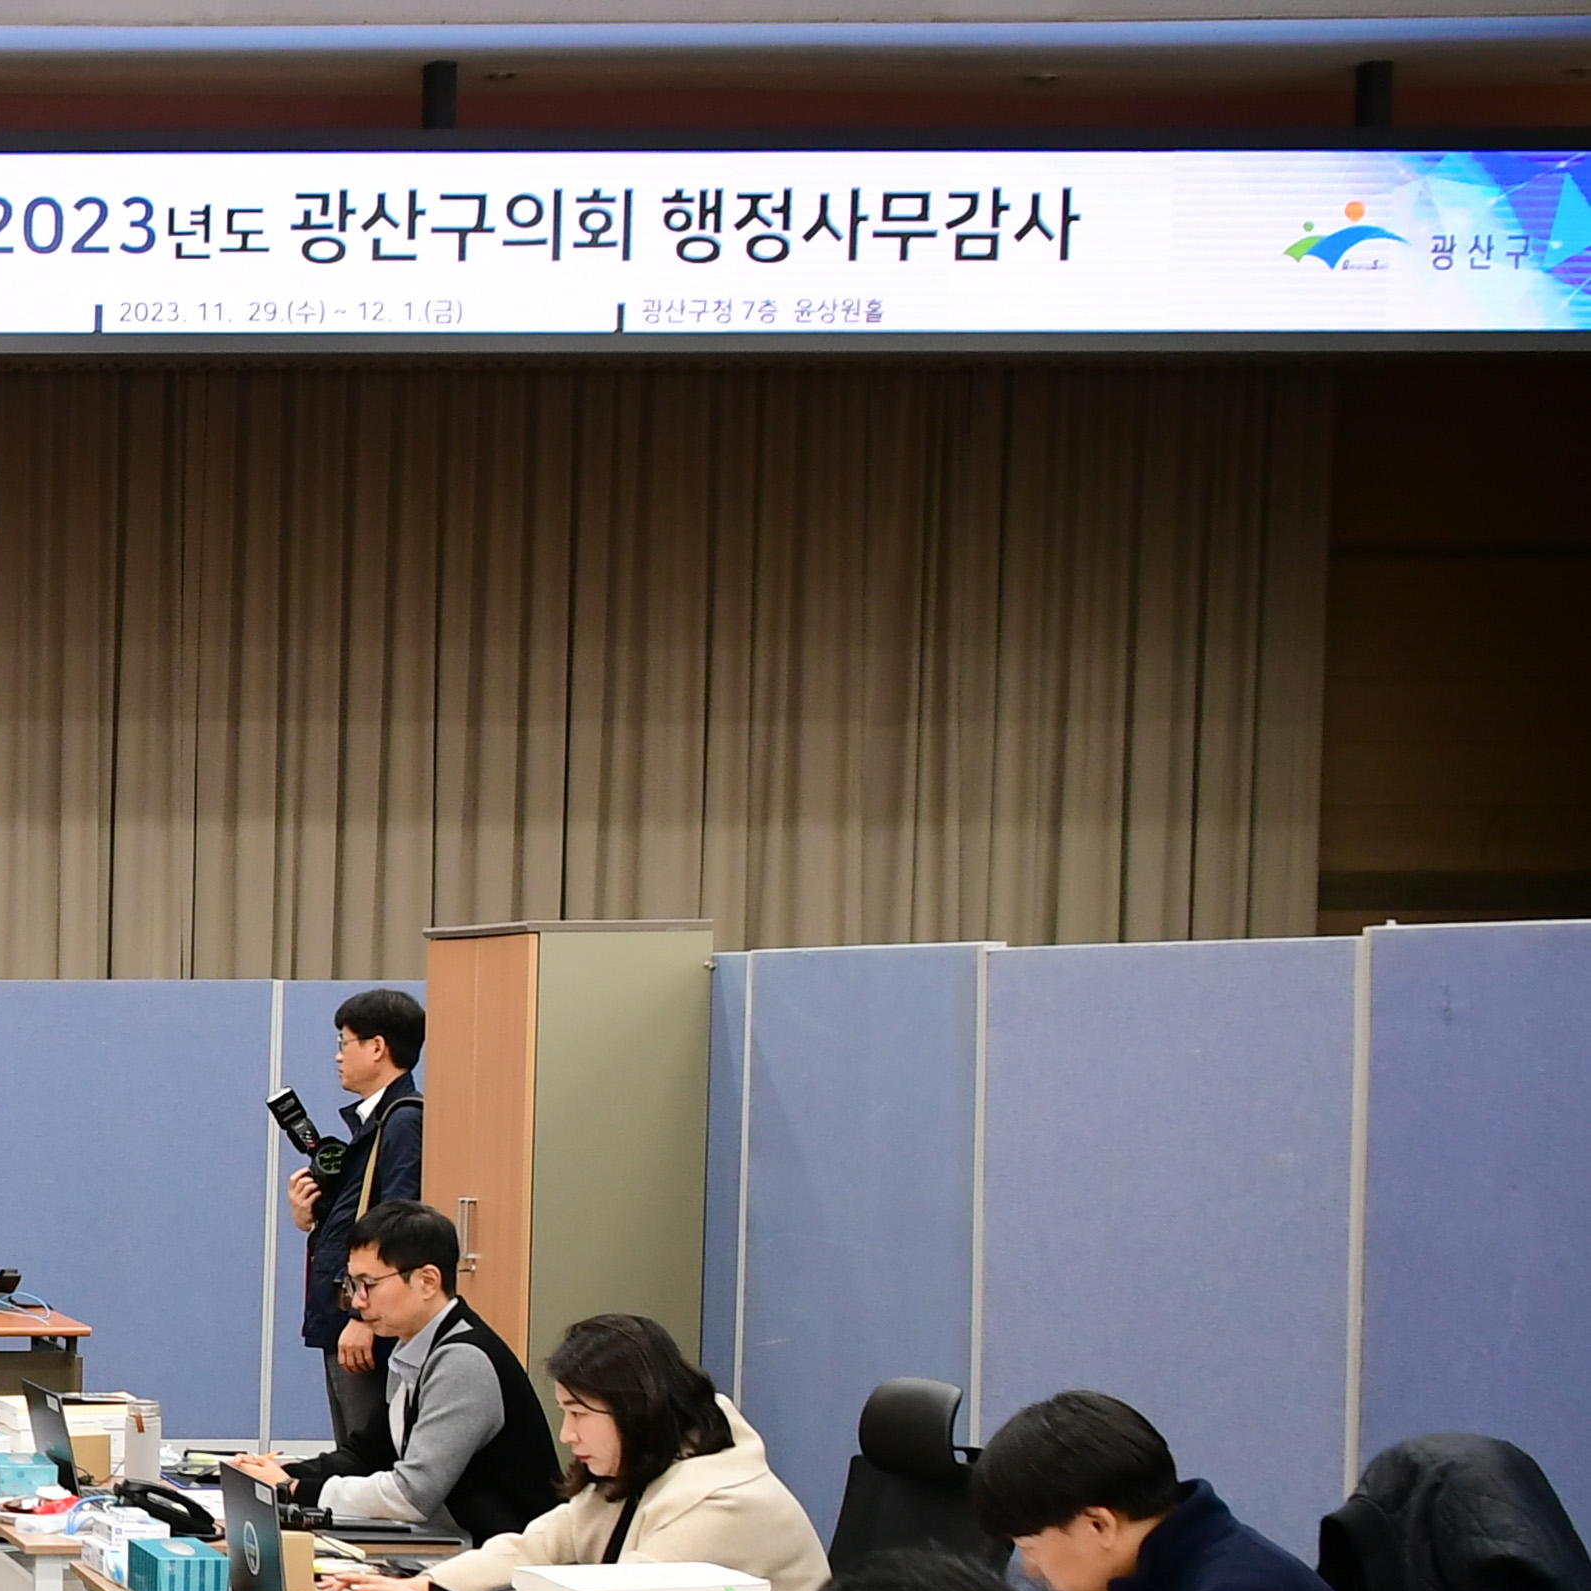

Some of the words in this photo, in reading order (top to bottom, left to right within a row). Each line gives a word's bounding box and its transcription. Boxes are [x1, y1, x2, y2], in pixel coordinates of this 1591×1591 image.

[290, 187, 634, 264] 광산구의회
[661, 186, 1082, 264] 행정사무감사
[1429, 234, 1533, 271] 광산구
[119, 301, 187, 323] 2023.
[198, 301, 232, 323] 11.
[357, 301, 392, 322] 12.
[641, 297, 734, 325] 광산구청
[742, 298, 779, 325] 7층
[793, 297, 884, 325] 윤상원홀
